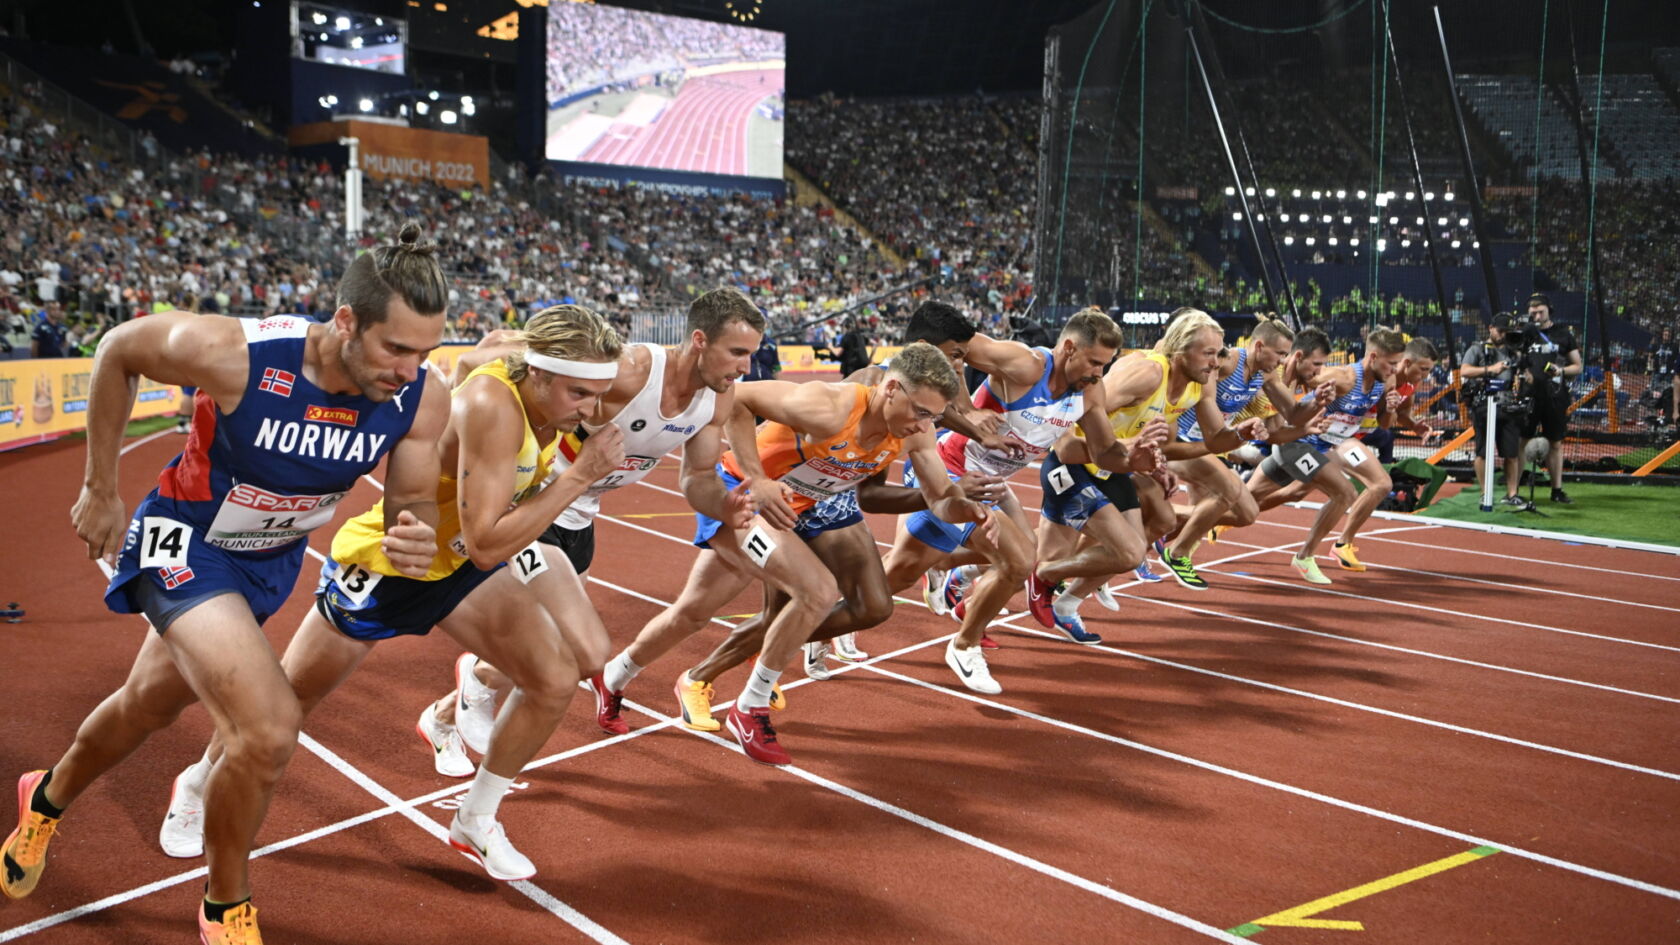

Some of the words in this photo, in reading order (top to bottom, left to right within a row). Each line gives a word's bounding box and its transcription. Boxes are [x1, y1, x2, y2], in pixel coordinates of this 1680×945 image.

[364, 153, 431, 177] MUNICH
[436, 161, 475, 181] 2022
[323, 410, 354, 421] EXTRA
[254, 417, 387, 462] NORWAY
[1301, 459, 1314, 471] 2
[1350, 451, 1360, 462] 1
[811, 460, 856, 481] SPAR
[602, 475, 624, 486] 12
[816, 478, 836, 489] 11
[1053, 472, 1063, 488] 7
[231, 487, 317, 511] SPAR
[262, 516, 296, 530] 14
[148, 526, 183, 558] 14
[210, 538, 273, 549] MUNICH
[747, 534, 768, 558] 11
[516, 548, 541, 577] 12
[341, 563, 370, 593] 13
